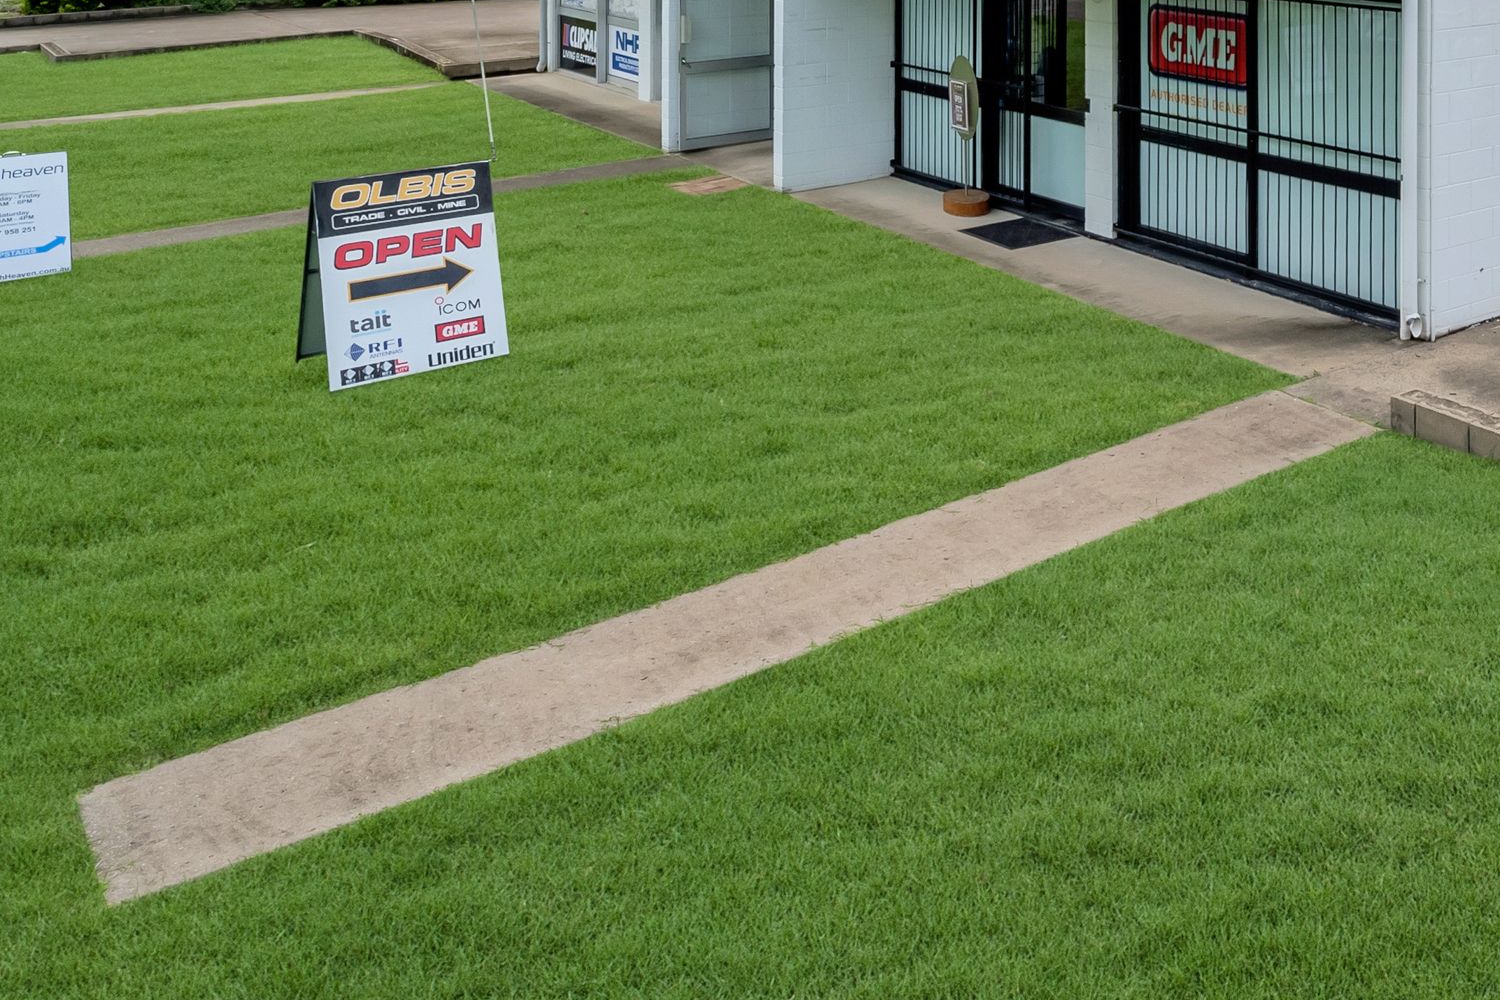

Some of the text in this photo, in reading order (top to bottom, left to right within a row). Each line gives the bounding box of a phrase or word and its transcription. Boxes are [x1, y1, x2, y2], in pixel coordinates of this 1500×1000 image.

[1161, 21, 1236, 71] GME
[1151, 89, 1208, 109] AUTHORISED
[1, 164, 65, 180] heaven
[330, 168, 476, 211] OLBIS
[343, 199, 466, 225] TRADE CIVIL MINE
[334, 222, 483, 270] OPEN
[442, 320, 478, 338] GME
[369, 338, 403, 353] RFI
[428, 342, 495, 367] Uniden
